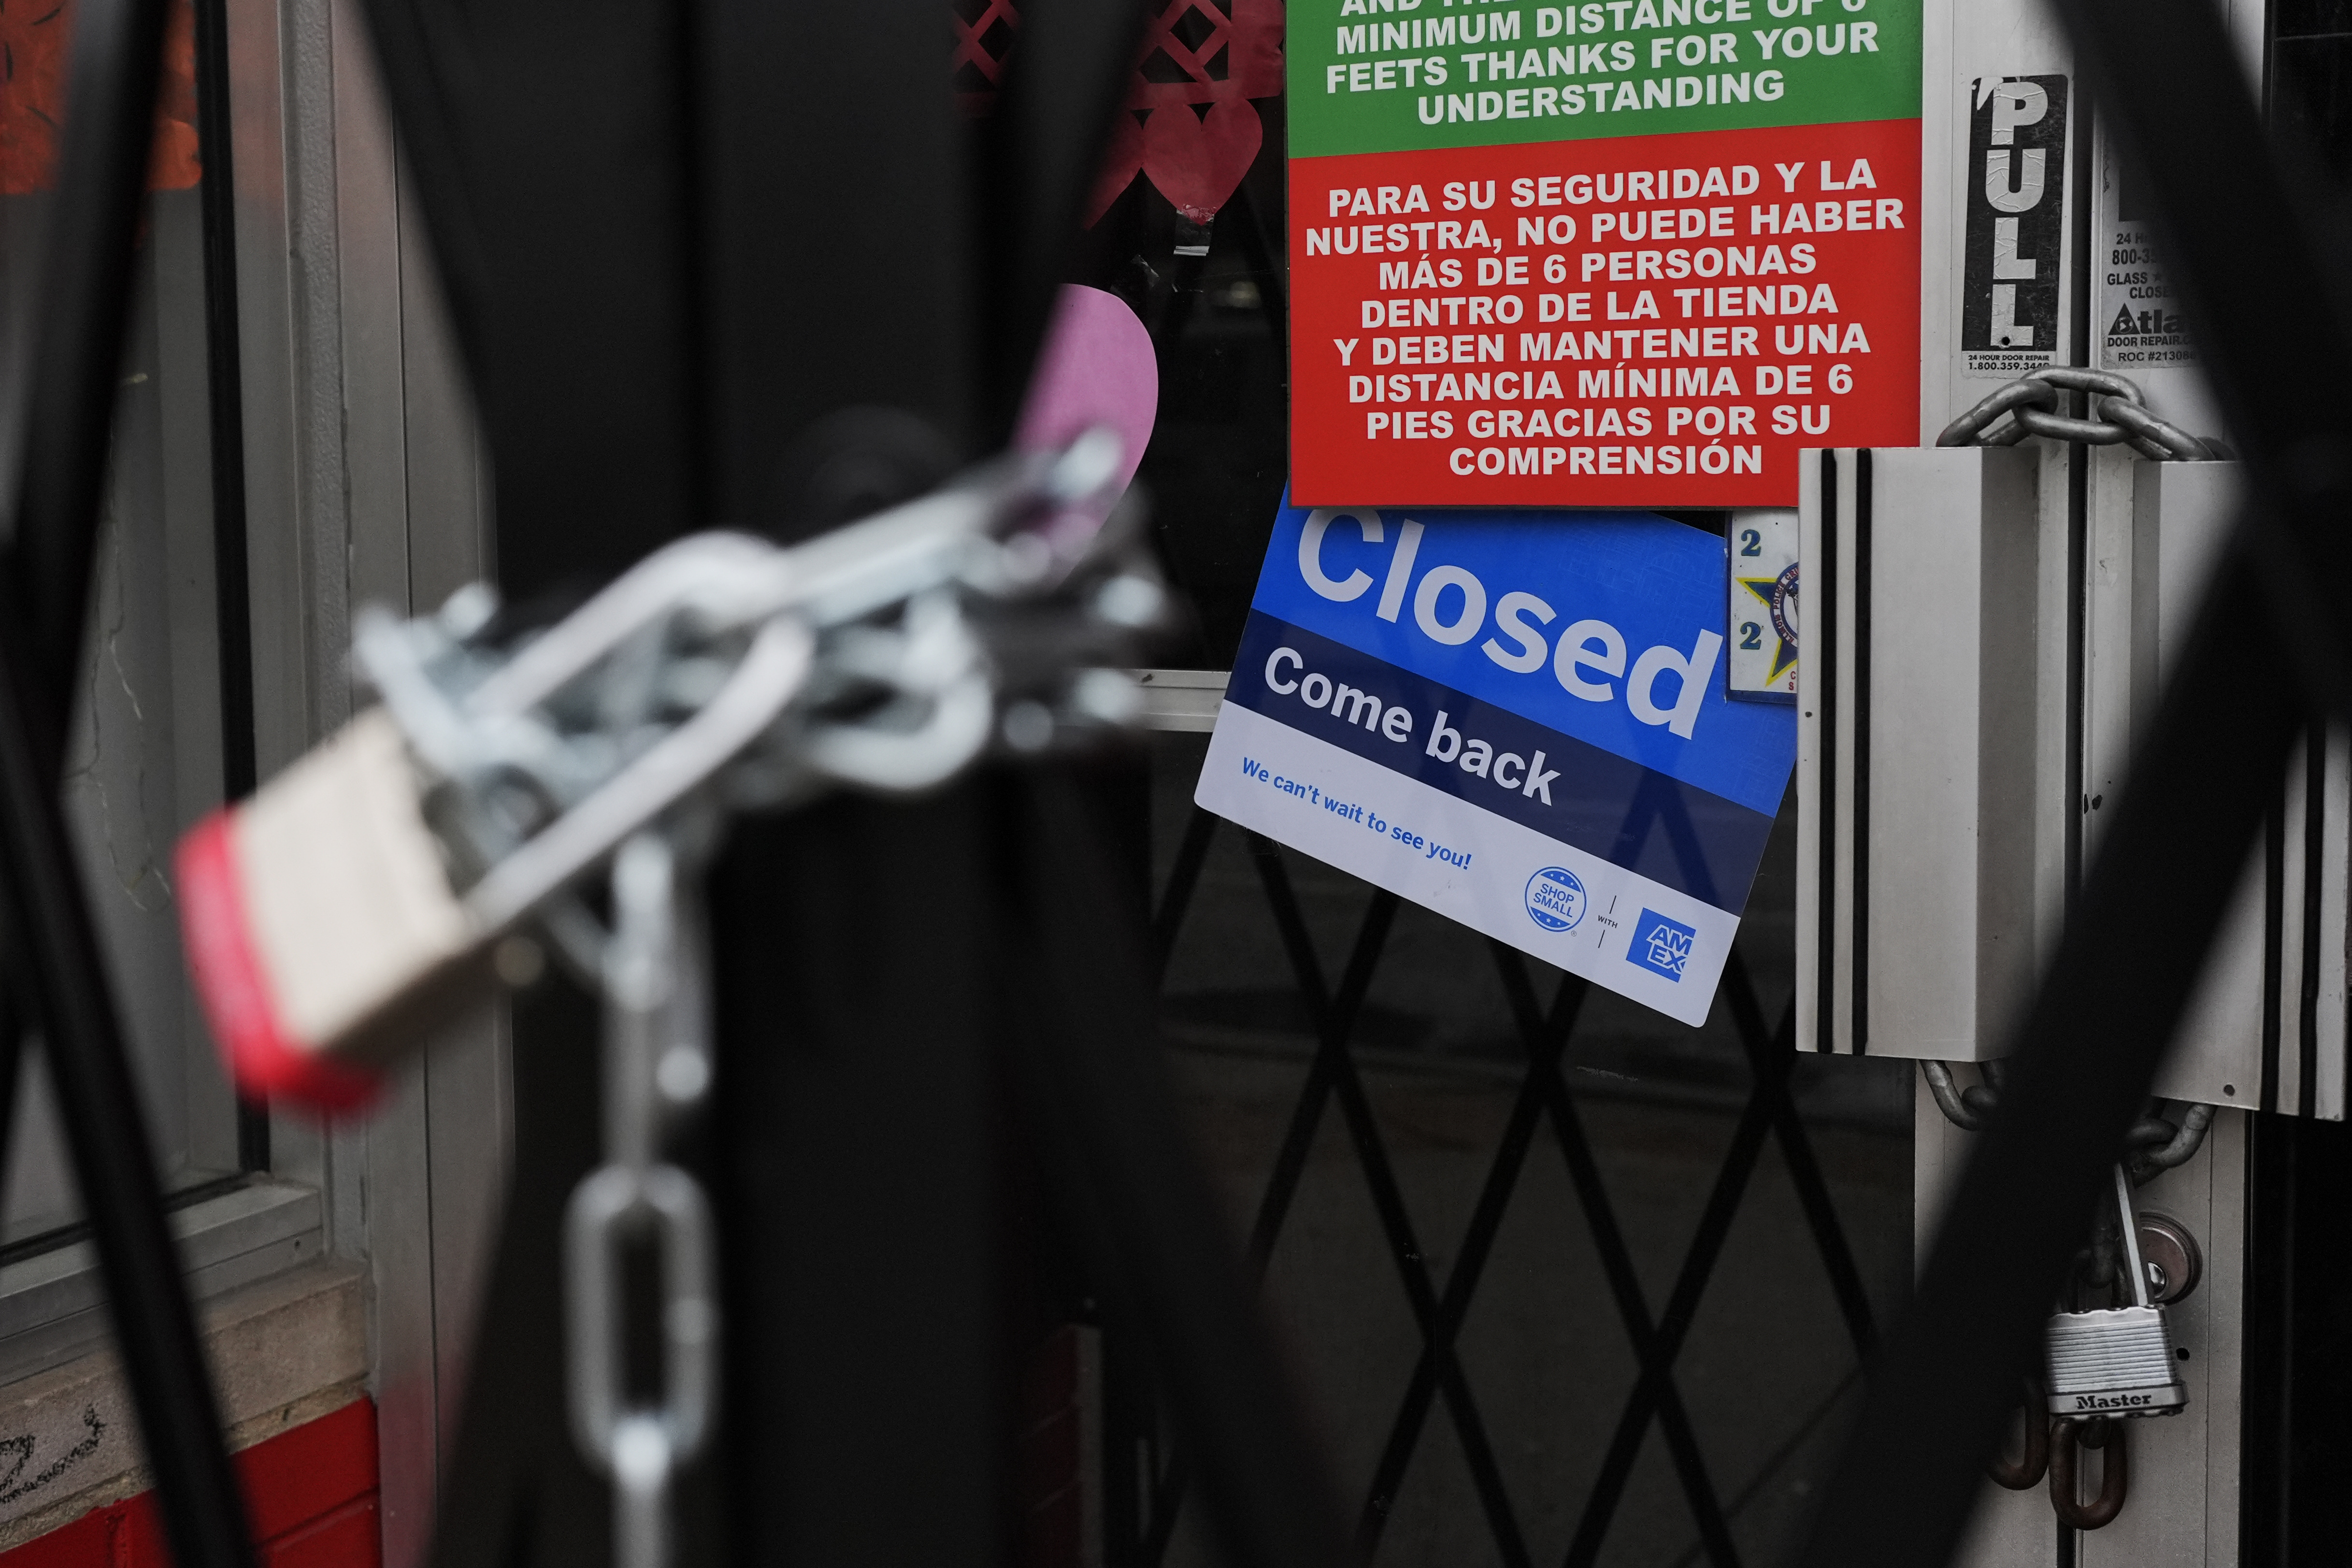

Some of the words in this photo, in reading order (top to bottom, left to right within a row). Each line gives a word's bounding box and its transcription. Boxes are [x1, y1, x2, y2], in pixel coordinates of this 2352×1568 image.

[1337, 10, 1520, 55] MINIMUM
[1536, 0, 1751, 38] DISTANCE
[1327, 56, 1448, 94] FEETS
[1461, 41, 1635, 83] THANKS
[1651, 32, 1739, 69] FOR
[1752, 21, 1879, 60] YOUR
[1418, 70, 1784, 125] UNDERSTANDING
[1329, 184, 1430, 217] PARA
[1442, 180, 1495, 211] SU
[1510, 165, 1760, 207] SEGURIDAD
[1774, 162, 1805, 193] Y
[1821, 158, 1877, 191] LA
[1306, 219, 1502, 256] NUESTRA,
[1518, 215, 1576, 246] NO
[1592, 206, 1735, 243] PUEDE
[1751, 198, 1905, 235] HABER
[1985, 81, 2048, 346] PULL
[2116, 233, 2131, 245] 24
[1379, 253, 1463, 290] MÁS
[1477, 256, 1529, 286] DE
[1543, 254, 1566, 284] 6
[1581, 243, 1816, 282] PERSONAS
[2107, 272, 2148, 285] GLASS
[1362, 295, 1523, 328] DENTRO
[1539, 292, 1592, 322] DE
[1607, 290, 1661, 320] LA
[1673, 283, 1839, 318] TIENDA
[1333, 338, 1359, 366] Y
[1373, 334, 1504, 365] DEBEN
[1520, 326, 1760, 361] MANTENER
[1775, 323, 1871, 355] UNA
[2107, 337, 2137, 347] DOOR
[2118, 352, 2144, 361] ROC
[1349, 371, 1564, 403] DISTANCIA
[1578, 362, 1741, 399] MÍNIMA
[1756, 365, 1812, 395] DE
[1828, 363, 1853, 394] 6
[1367, 410, 1454, 439] PIES
[1467, 407, 1652, 438] GRACIAS
[1668, 406, 1757, 436] POR
[1771, 404, 1830, 435] SU
[1449, 438, 1762, 475] COMPRENSIÓN
[1740, 529, 1762, 557] 2
[1298, 509, 1723, 740] Closed
[1740, 621, 1761, 650] 2
[1265, 647, 1412, 743] Come
[1425, 709, 1562, 806] back
[1243, 757, 1269, 783] We
[1324, 796, 1363, 824] wait
[1367, 812, 1387, 834] to
[1390, 827, 1424, 850] see
[1425, 842, 1473, 871] you!
[1533, 892, 1573, 919] SMALL
[1540, 883, 1575, 904] SHOP
[1597, 915, 1619, 929] WITH
[1648, 925, 1693, 956] AM
[1647, 943, 1687, 974] EX
[2076, 1394, 2152, 1410] Master
